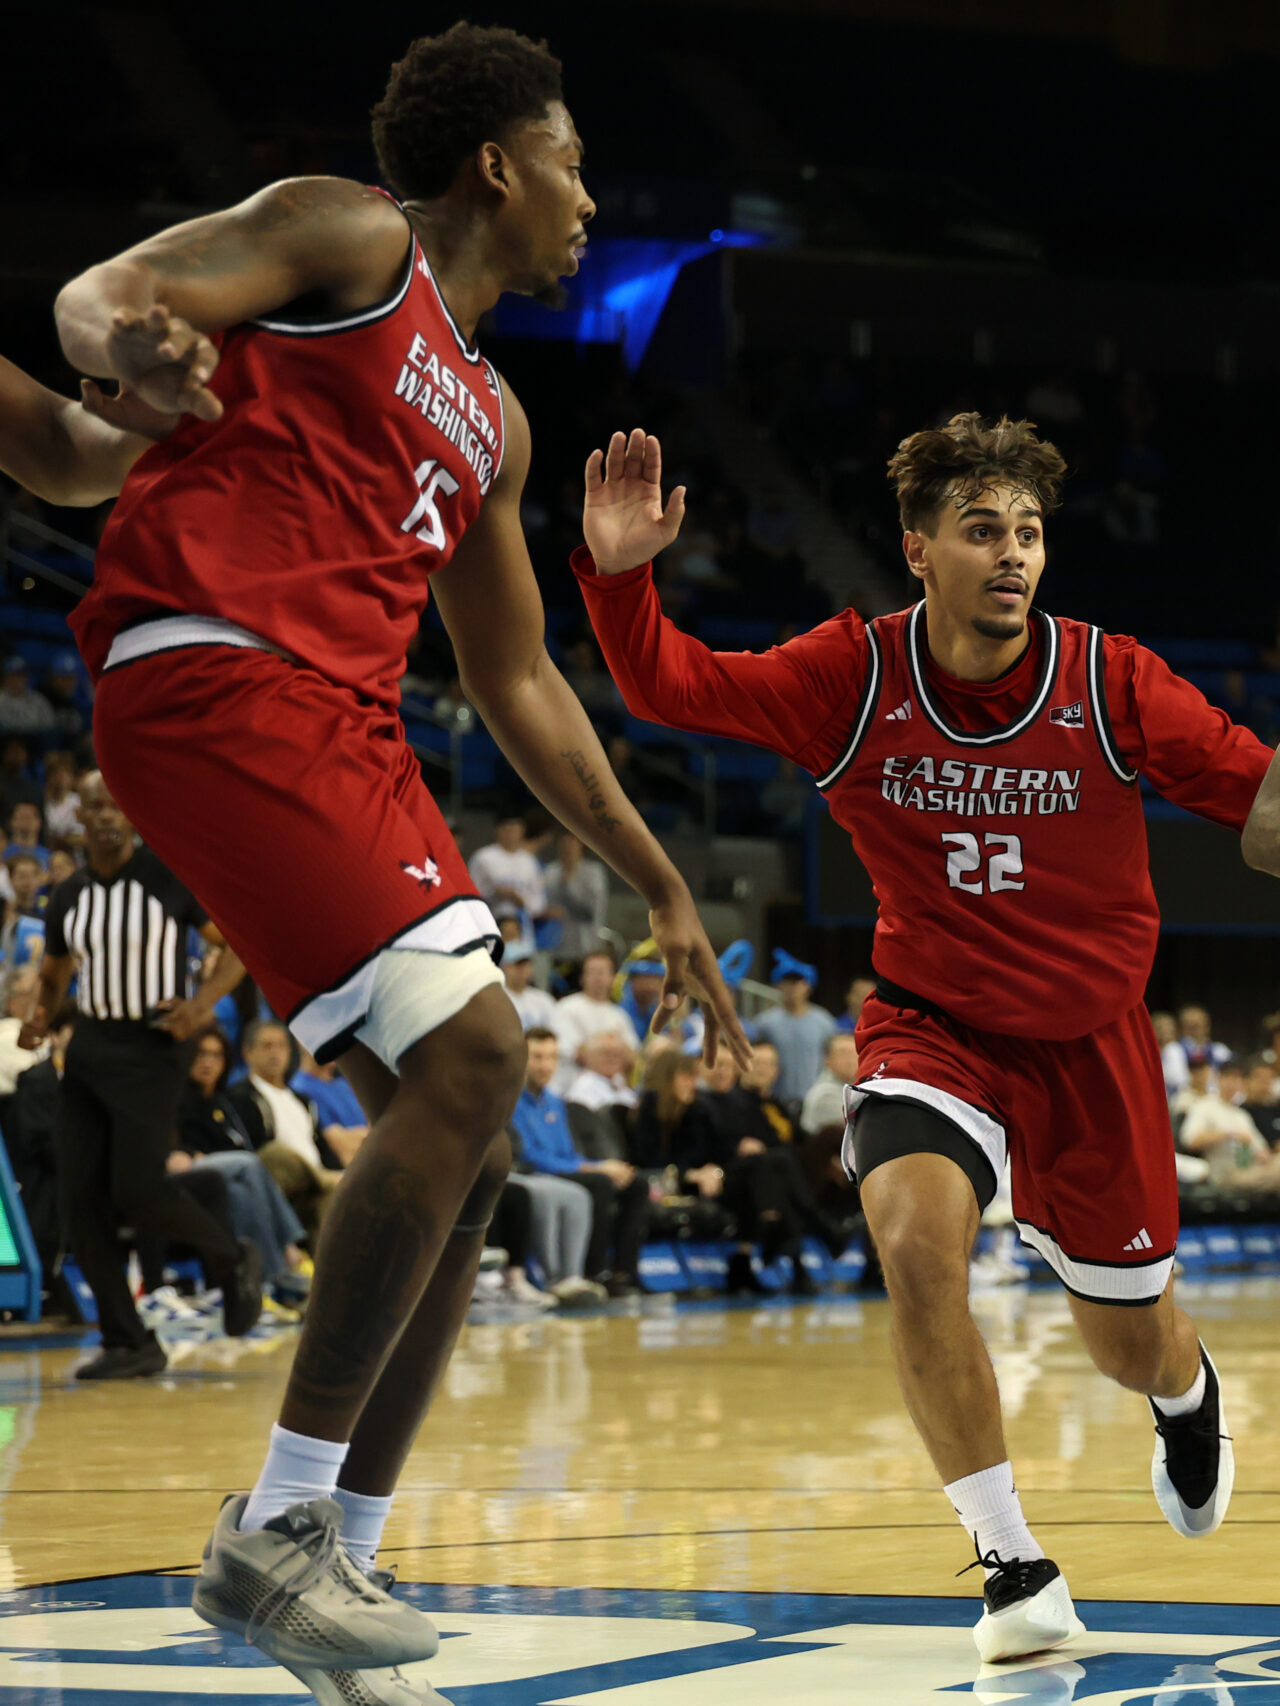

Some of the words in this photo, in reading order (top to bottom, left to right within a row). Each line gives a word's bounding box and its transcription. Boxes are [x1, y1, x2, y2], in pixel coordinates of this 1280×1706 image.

[400, 458, 460, 553] 15
[1063, 703, 1081, 719] SKY
[882, 755, 1081, 791] EASTERN
[881, 778, 1080, 816] WASHINGTON
[941, 832, 1025, 895] 22
